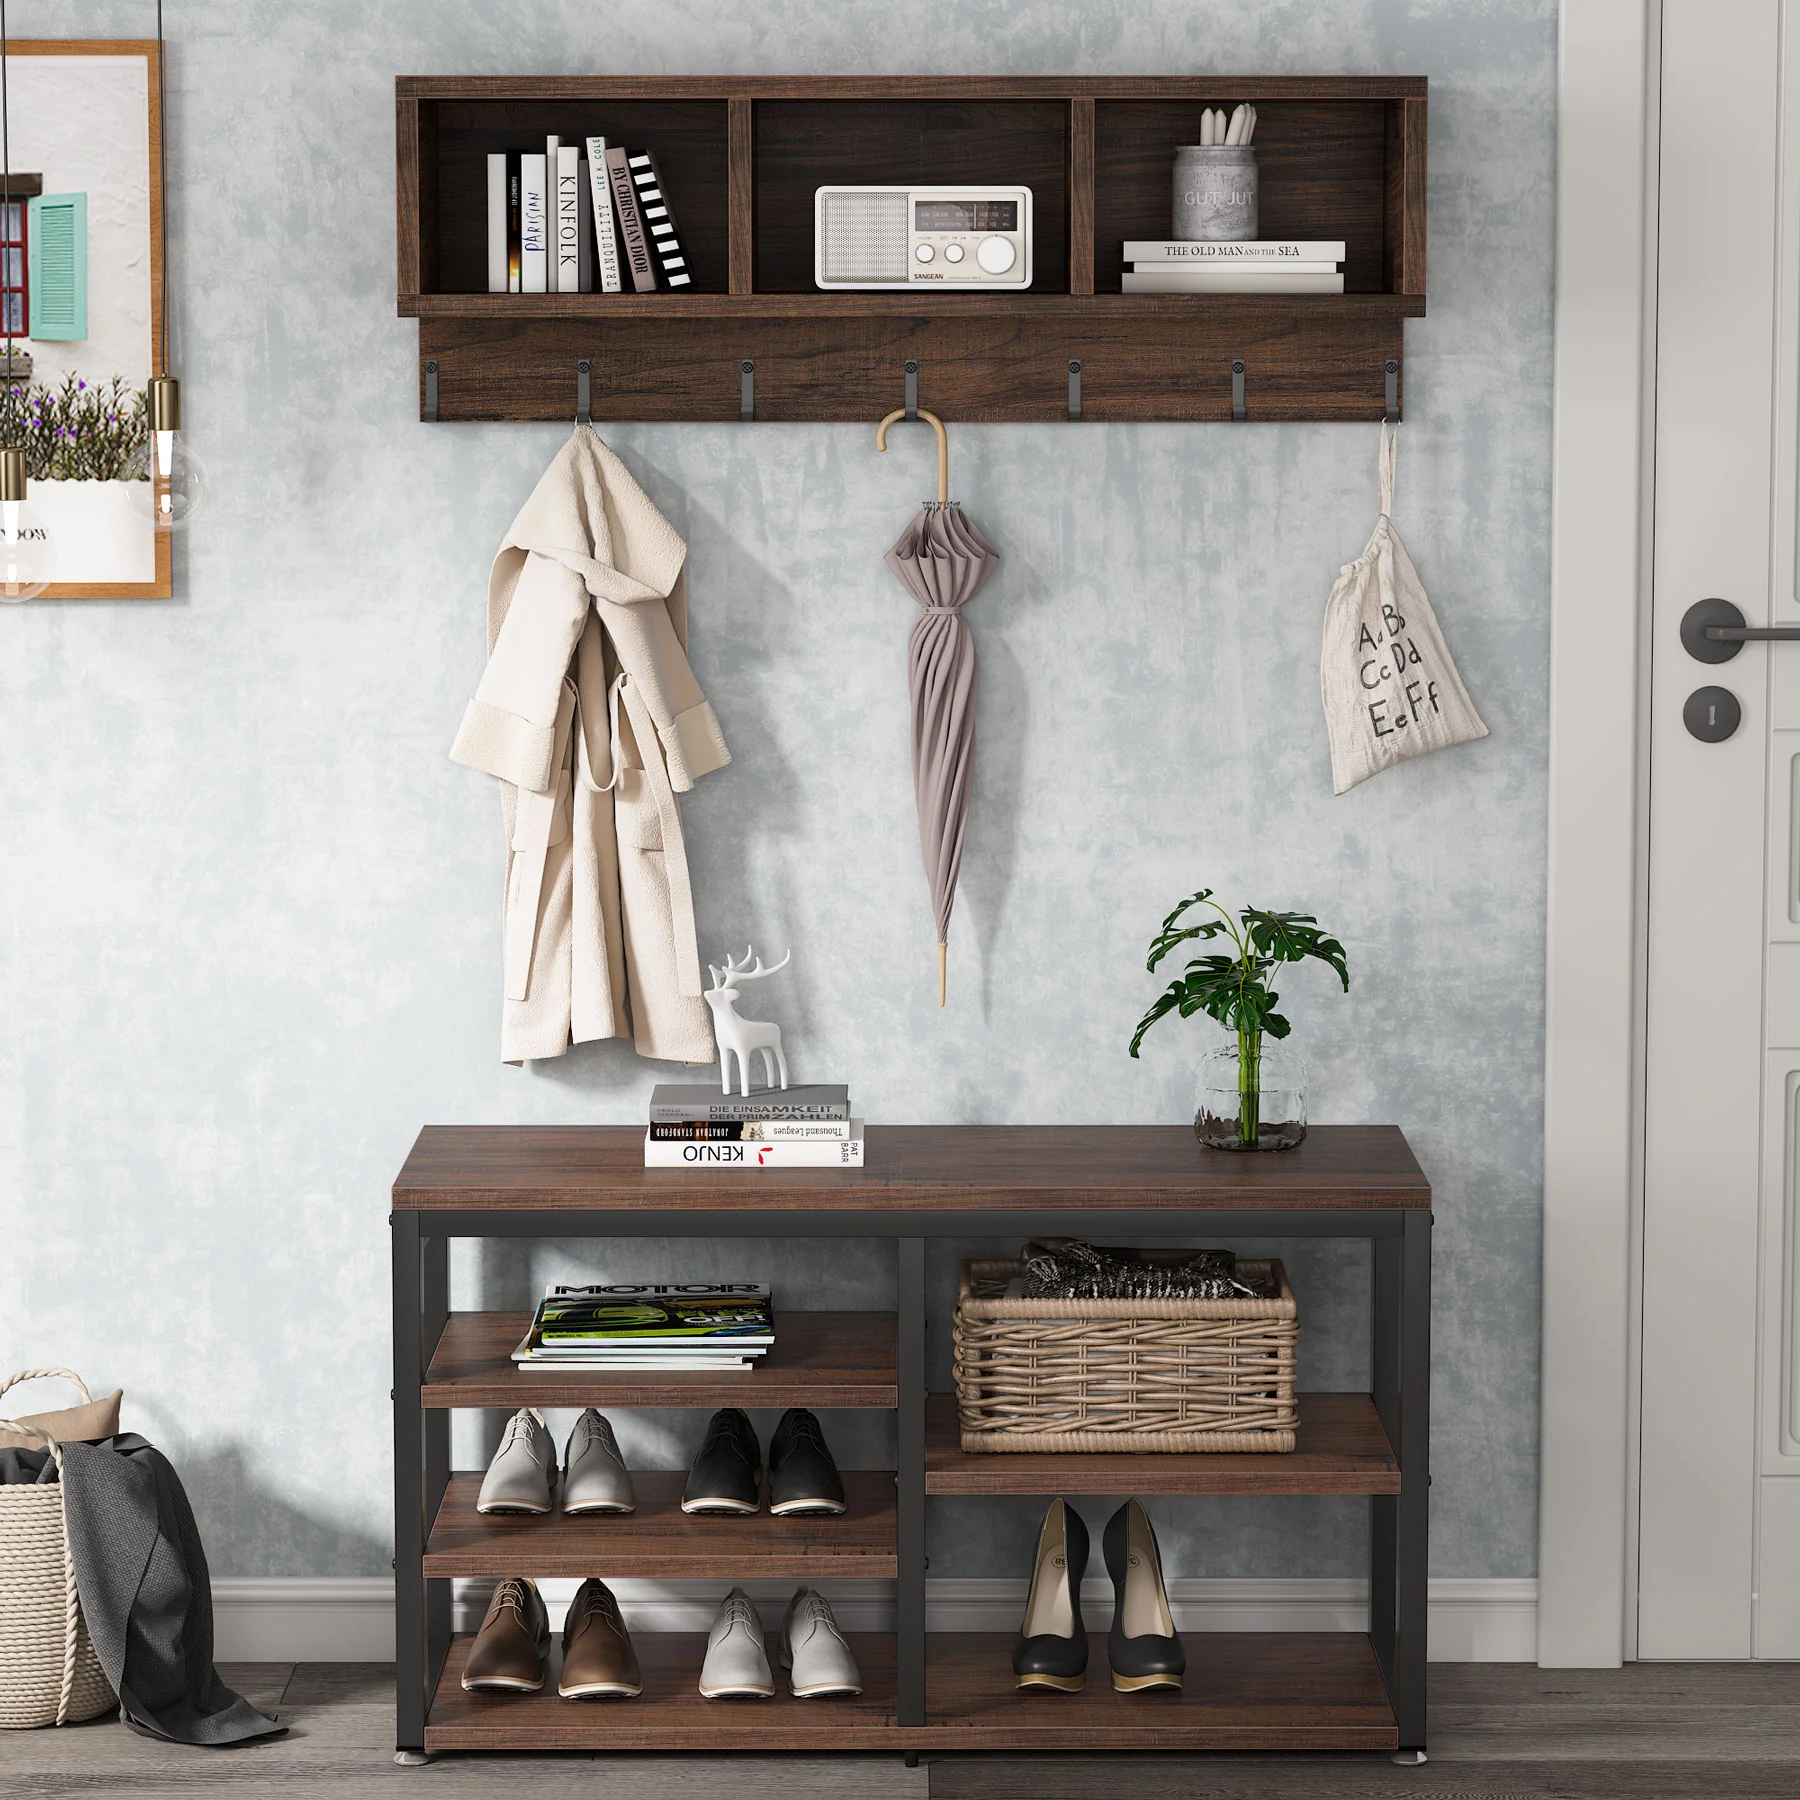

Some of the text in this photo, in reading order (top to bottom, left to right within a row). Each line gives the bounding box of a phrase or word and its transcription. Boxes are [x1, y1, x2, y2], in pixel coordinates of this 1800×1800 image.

[592, 138, 602, 160] COLE
[596, 175, 605, 191] LEE
[1184, 191, 1254, 205] GUT JUT
[521, 192, 545, 252] PARISIAN
[560, 176, 576, 266] KINFOLK
[612, 166, 648, 274] BY CHRISTIAN DIOR
[598, 204, 618, 287] TRANQUILITY
[1165, 246, 1300, 256] THE OLD MAN AND THE SEA
[709, 1105, 833, 1113] DIE EINSAMKEIT
[695, 1128, 729, 1137] JONATHAN
[773, 1126, 803, 1136] Leagues
[805, 1127, 843, 1136] Thousand
[683, 1145, 745, 1161] KENJO
[841, 1142, 849, 1163] BARR
[850, 1142, 858, 1156] PAT
[554, 1284, 760, 1295] MOTOR
[683, 1315, 766, 1324] OFF!
